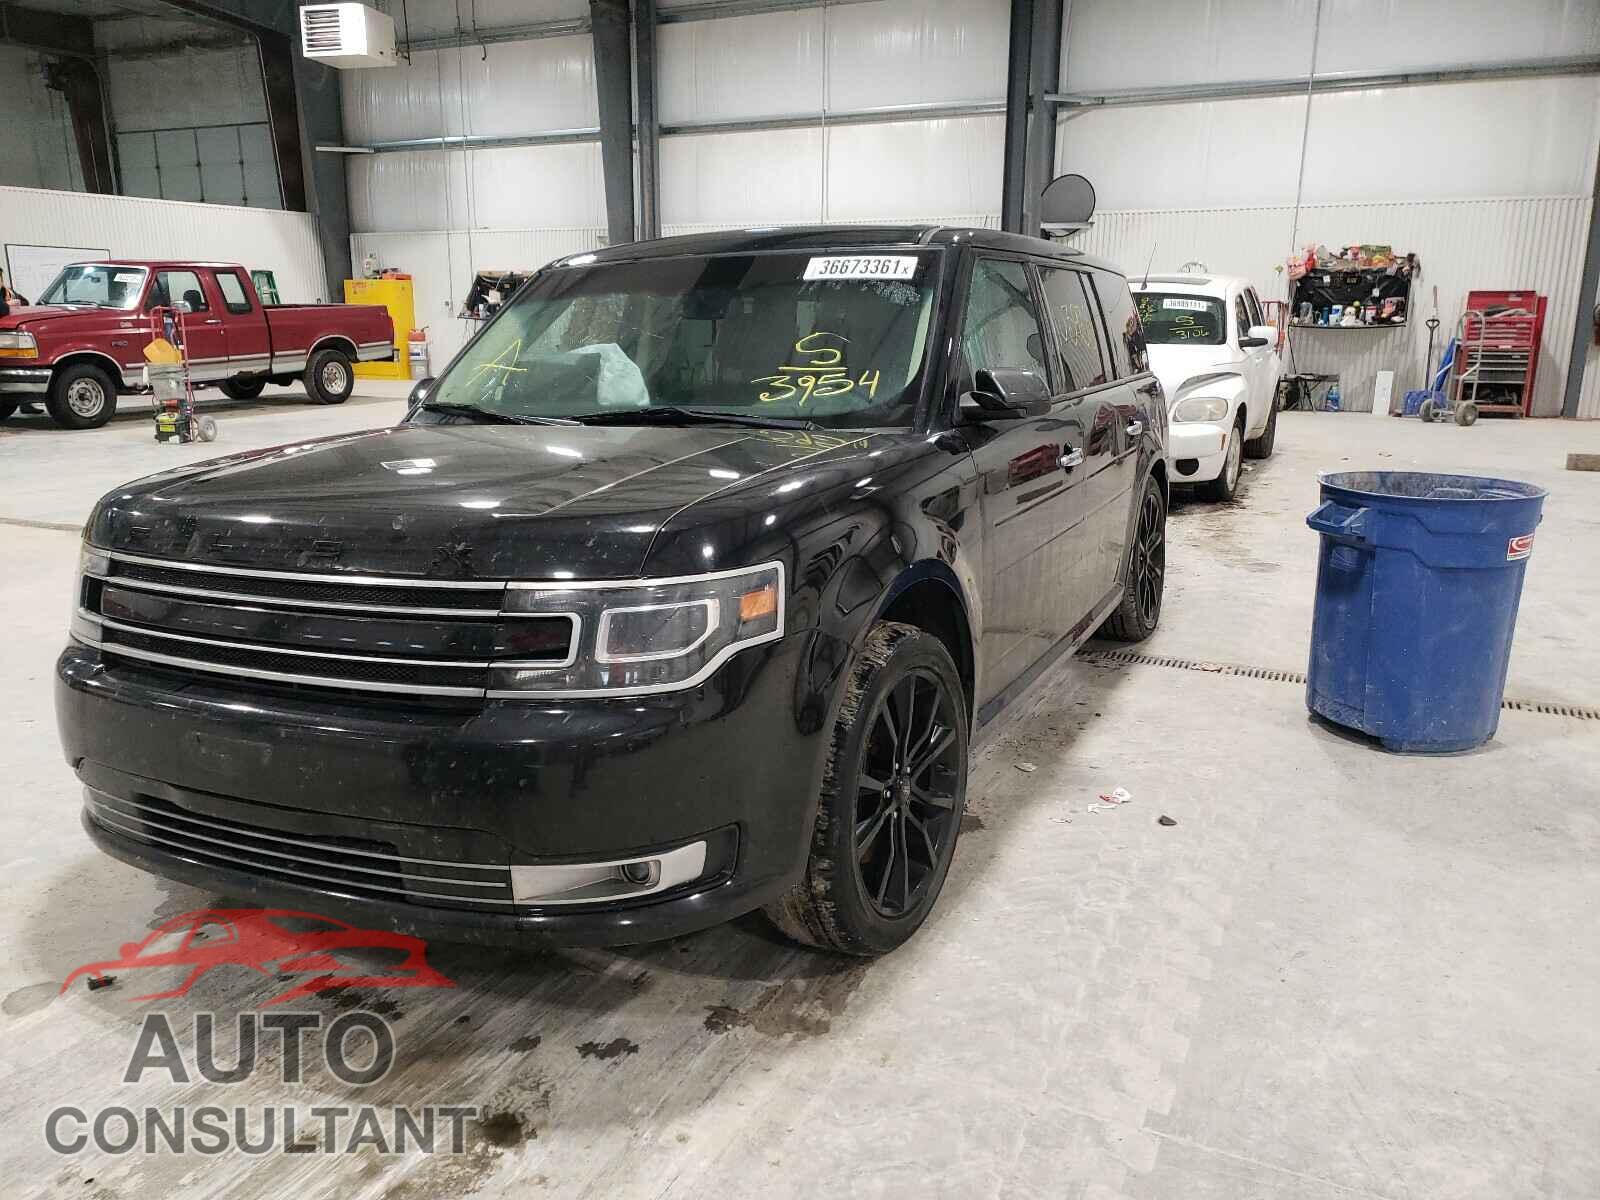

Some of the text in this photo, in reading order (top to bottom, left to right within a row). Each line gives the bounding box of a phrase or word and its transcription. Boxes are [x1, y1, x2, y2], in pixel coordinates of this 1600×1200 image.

[464, 338, 529, 386] A
[795, 331, 850, 365] S
[751, 369, 881, 407] 3954
